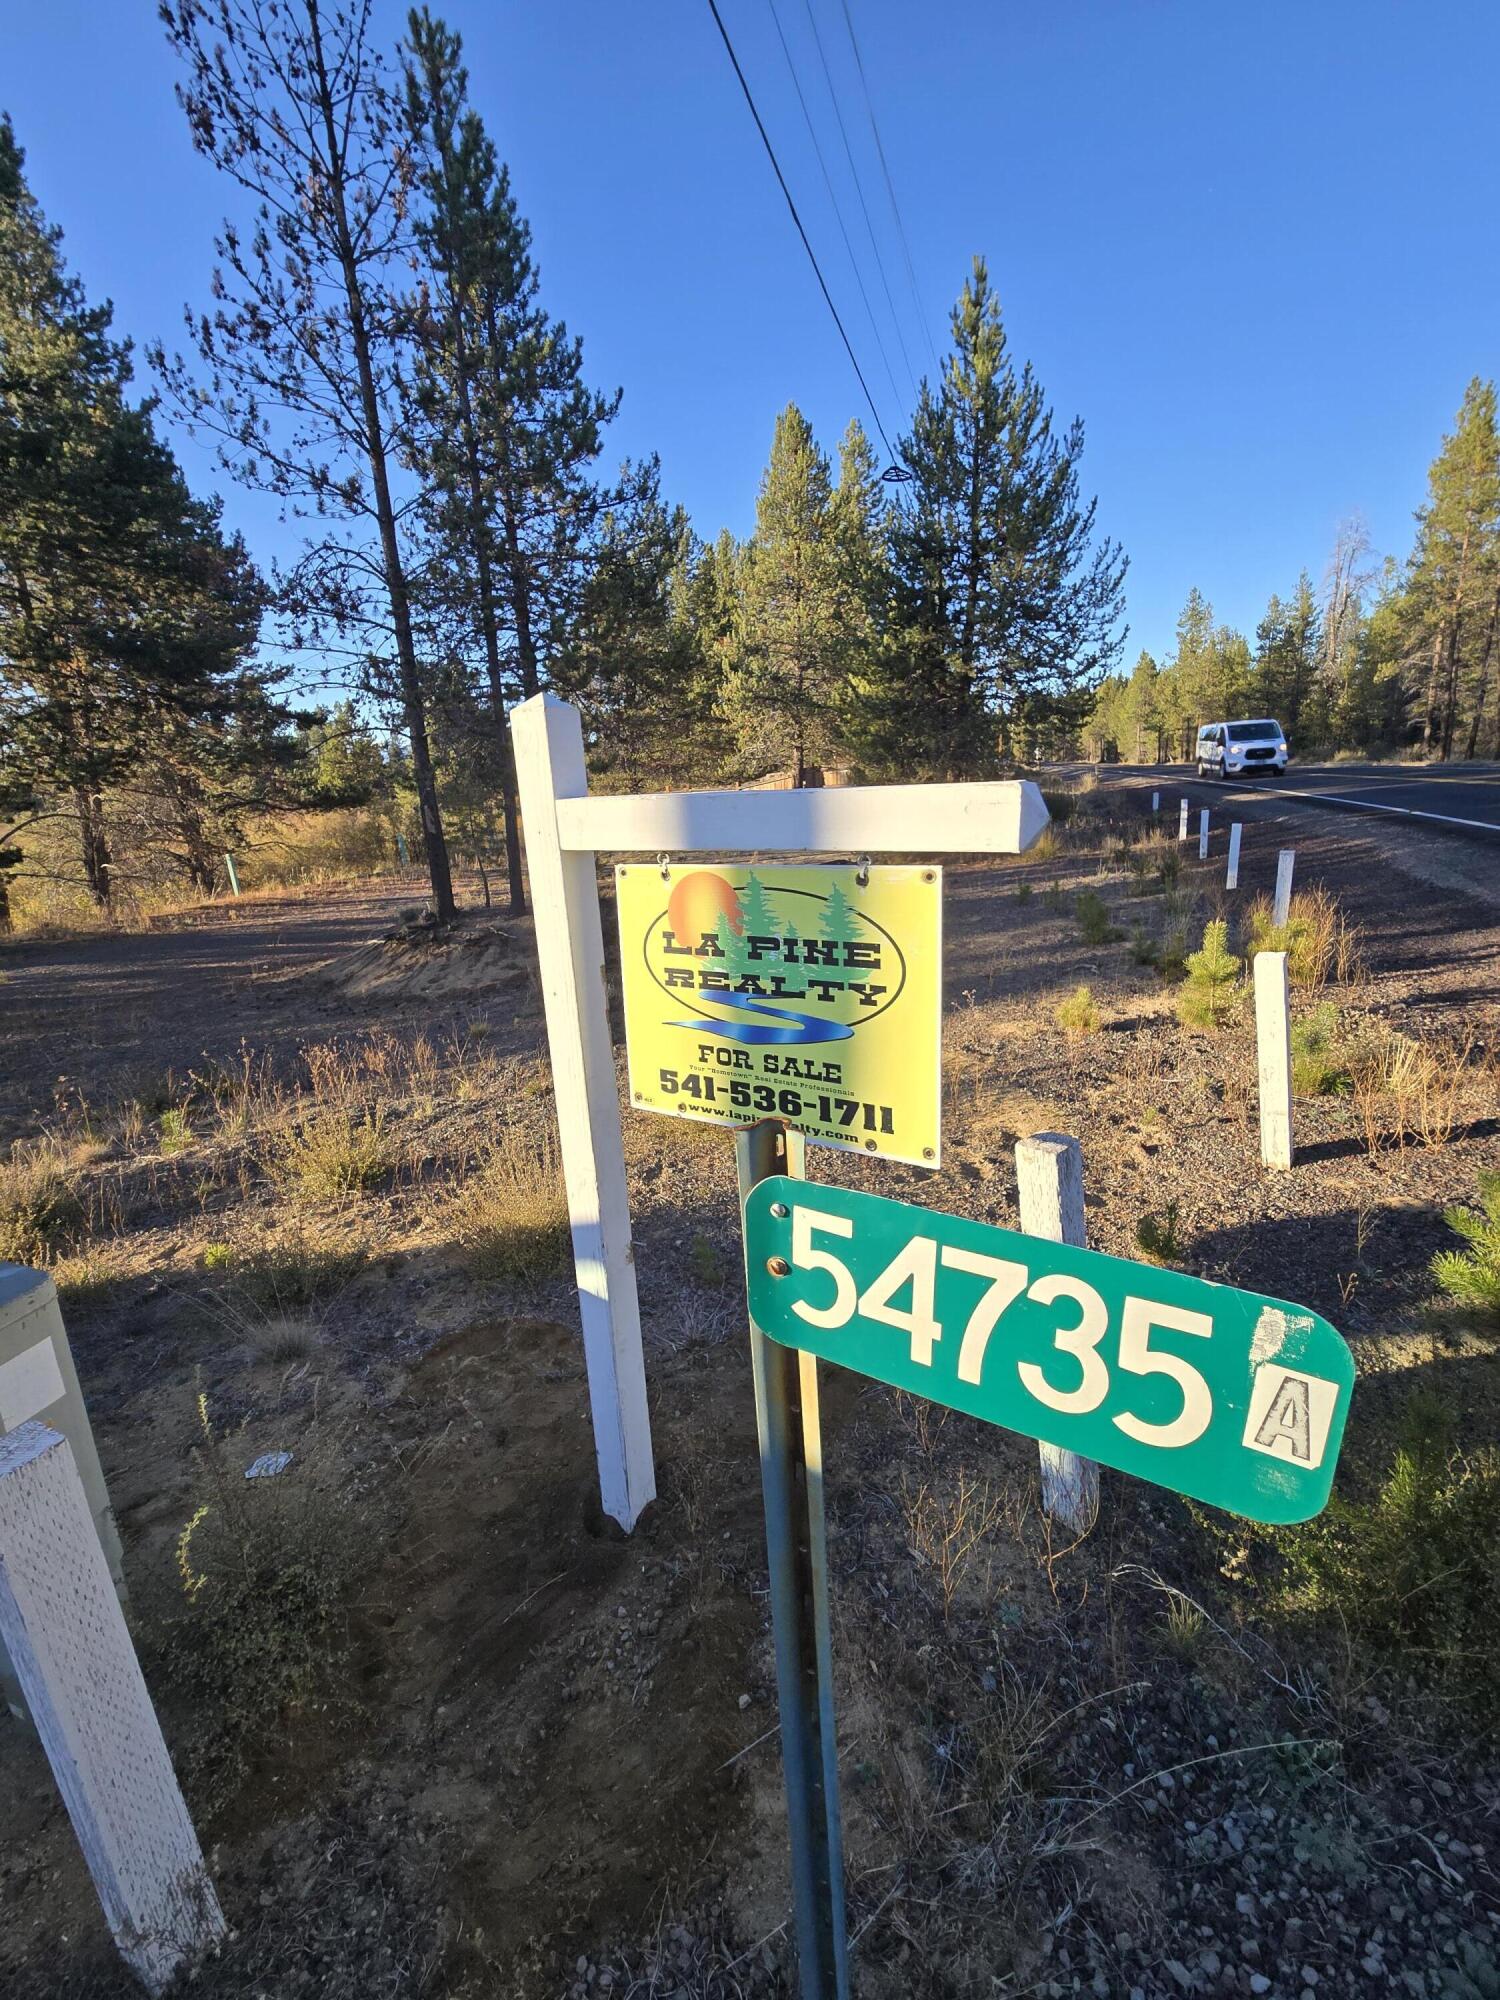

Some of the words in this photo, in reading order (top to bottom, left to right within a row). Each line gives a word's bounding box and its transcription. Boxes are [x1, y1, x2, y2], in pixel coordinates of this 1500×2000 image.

[662, 931, 725, 957] LA
[747, 935, 881, 969] PINE
[663, 967, 887, 1006] REALTY
[689, 1064, 705, 1072] Your
[754, 1074, 771, 1083] Real
[773, 1078, 797, 1087] Estate
[800, 1082, 855, 1097] Professionals
[698, 1044, 754, 1070] FOR
[763, 1053, 842, 1084] SALE
[659, 1068, 895, 1135] 541-536-1711
[790, 1205, 1213, 1449] 54735
[1253, 1376, 1311, 1462] A
